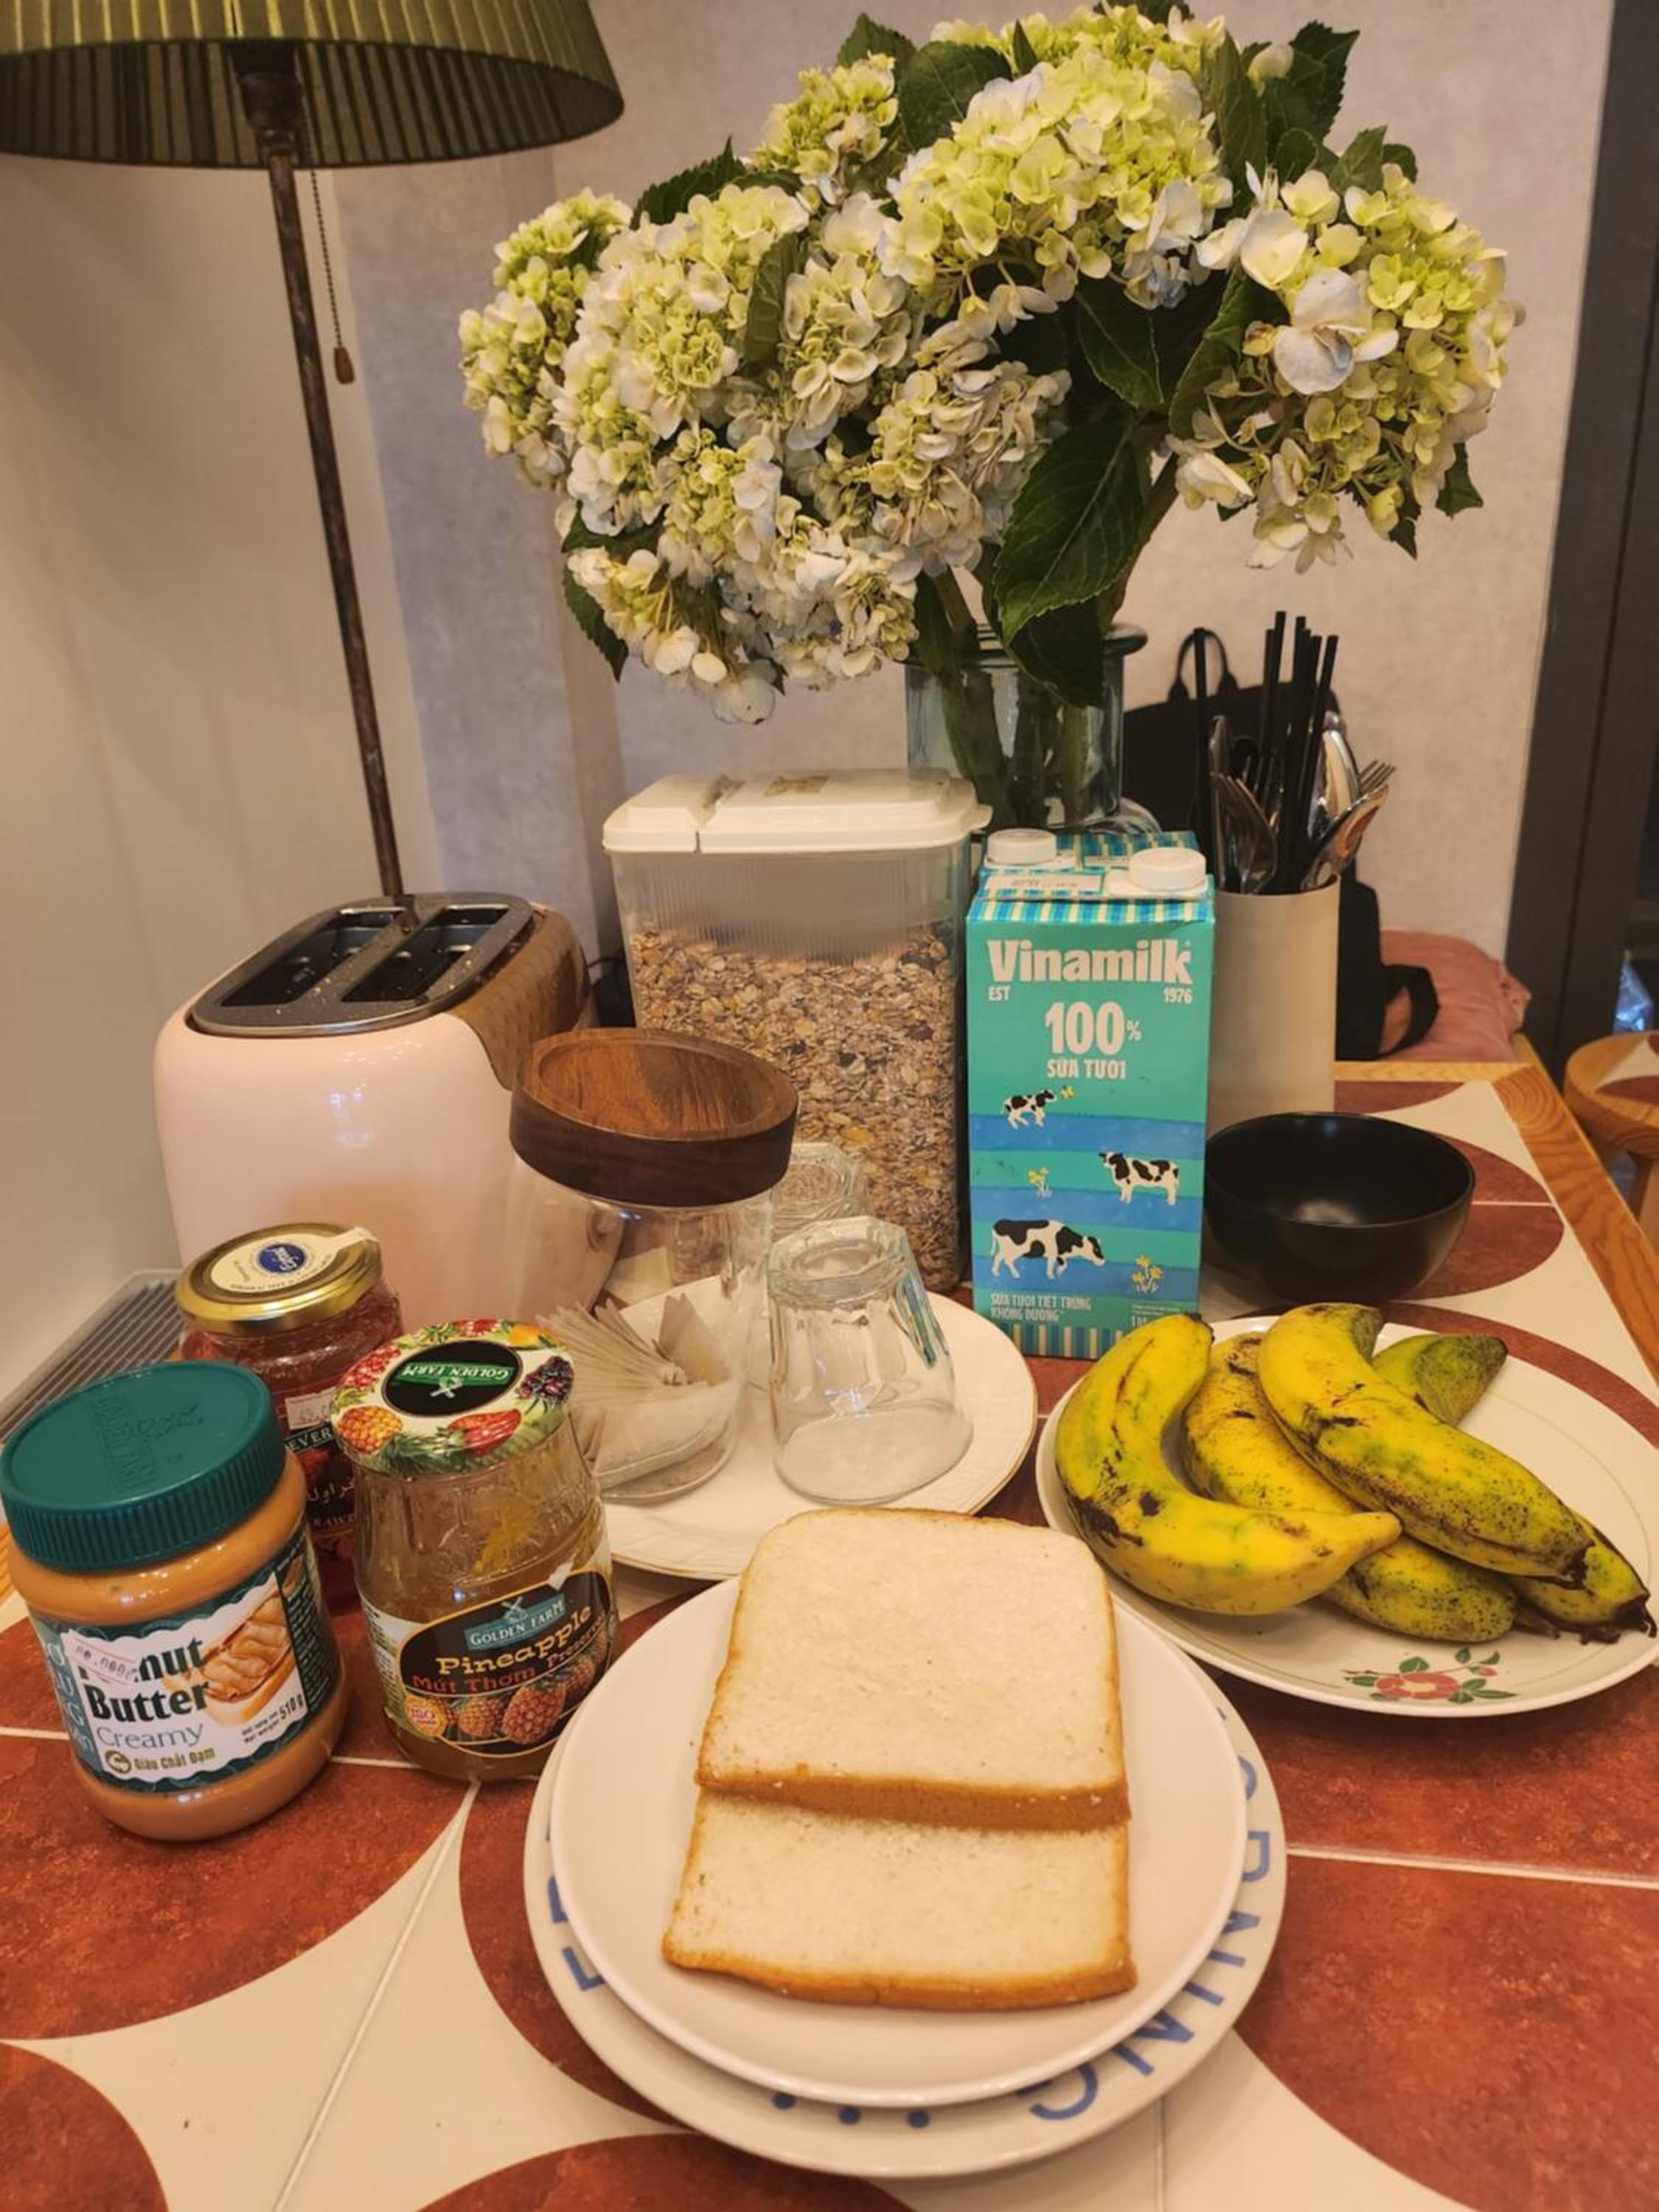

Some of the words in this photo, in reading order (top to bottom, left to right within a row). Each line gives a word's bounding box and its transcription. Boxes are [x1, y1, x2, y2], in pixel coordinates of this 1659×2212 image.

[987, 939, 1193, 984] Vinamilk
[988, 986, 1011, 1002] EST
[1163, 987, 1193, 1004] 1976
[1045, 1001, 1142, 1056] 100%
[402, 1365, 444, 1377] FARM
[449, 1367, 509, 1381] GOLDEN
[436, 1605, 591, 1675] Pineapple
[469, 1624, 526, 1646] GOLDEN
[530, 1599, 566, 1629] FARM
[83, 1680, 209, 1723] Butter
[279, 1697, 297, 1720] 510
[96, 1722, 204, 1750] Creamy
